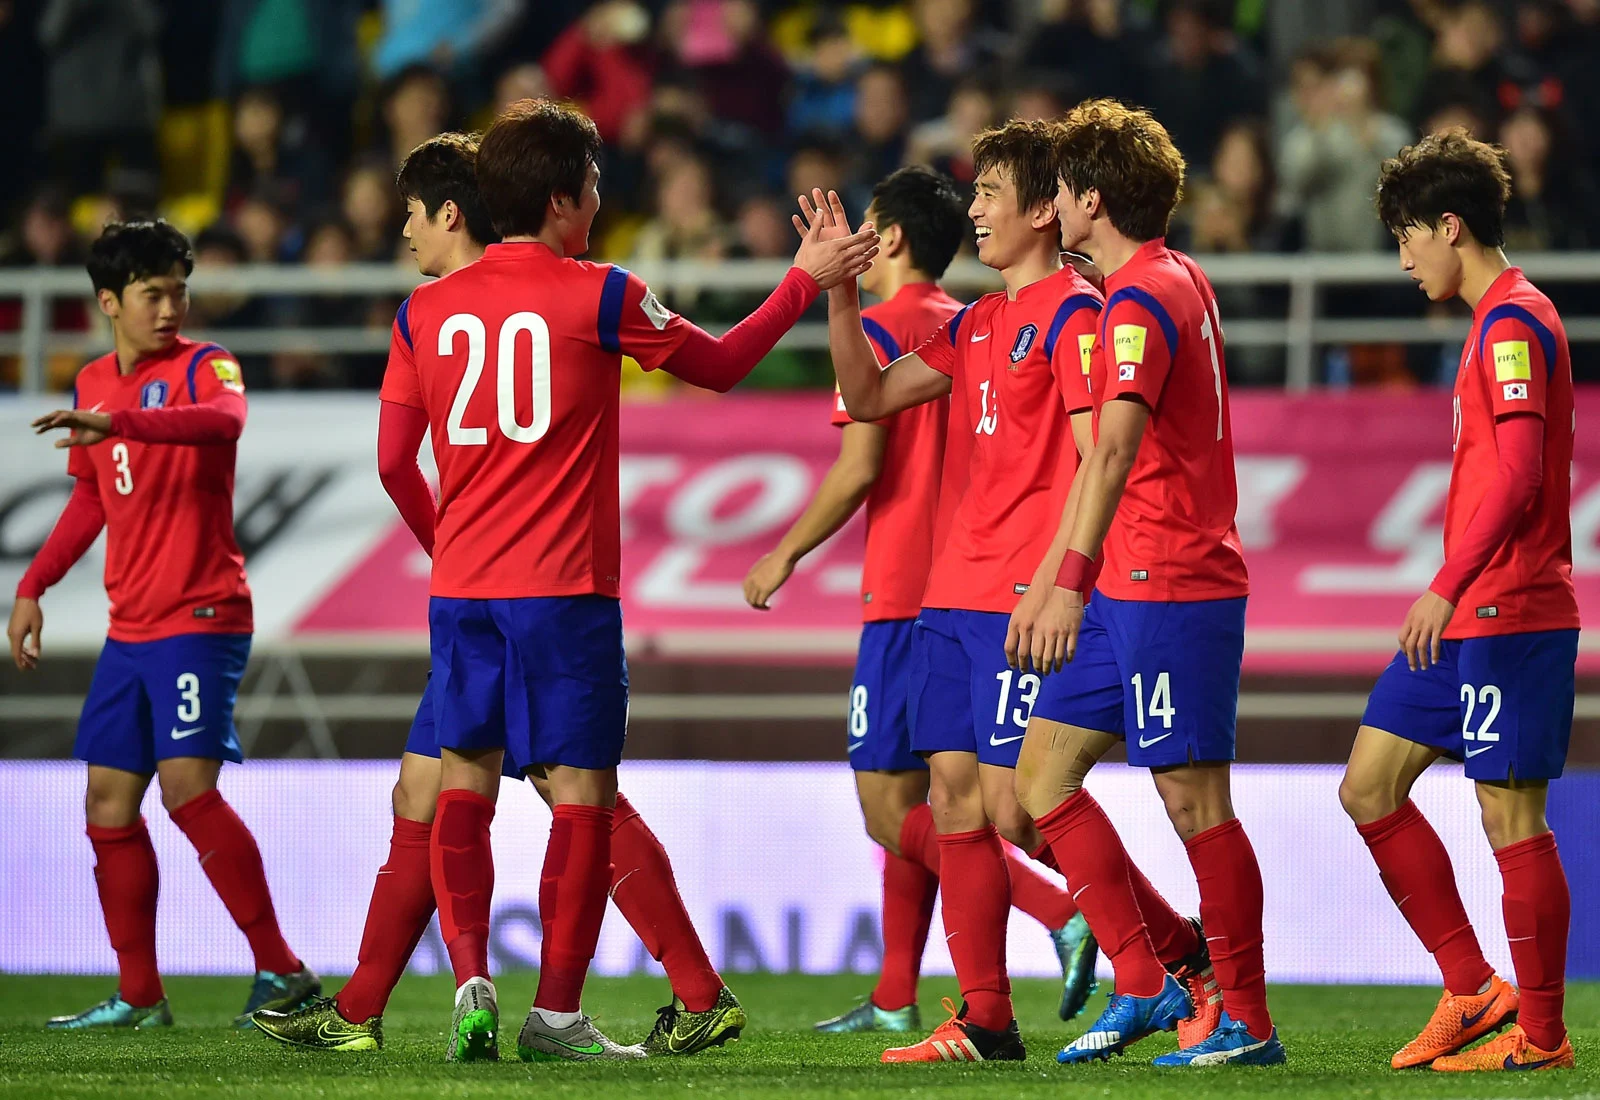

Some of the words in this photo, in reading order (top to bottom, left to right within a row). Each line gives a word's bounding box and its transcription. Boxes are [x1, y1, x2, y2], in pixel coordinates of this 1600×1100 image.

[438, 311, 552, 445] 20
[1497, 354, 1517, 363] FIFA
[112, 442, 134, 495] 3
[177, 672, 201, 723] 3
[994, 670, 1041, 728] 13
[1131, 672, 1176, 729] 14
[1460, 683, 1502, 742] 22
